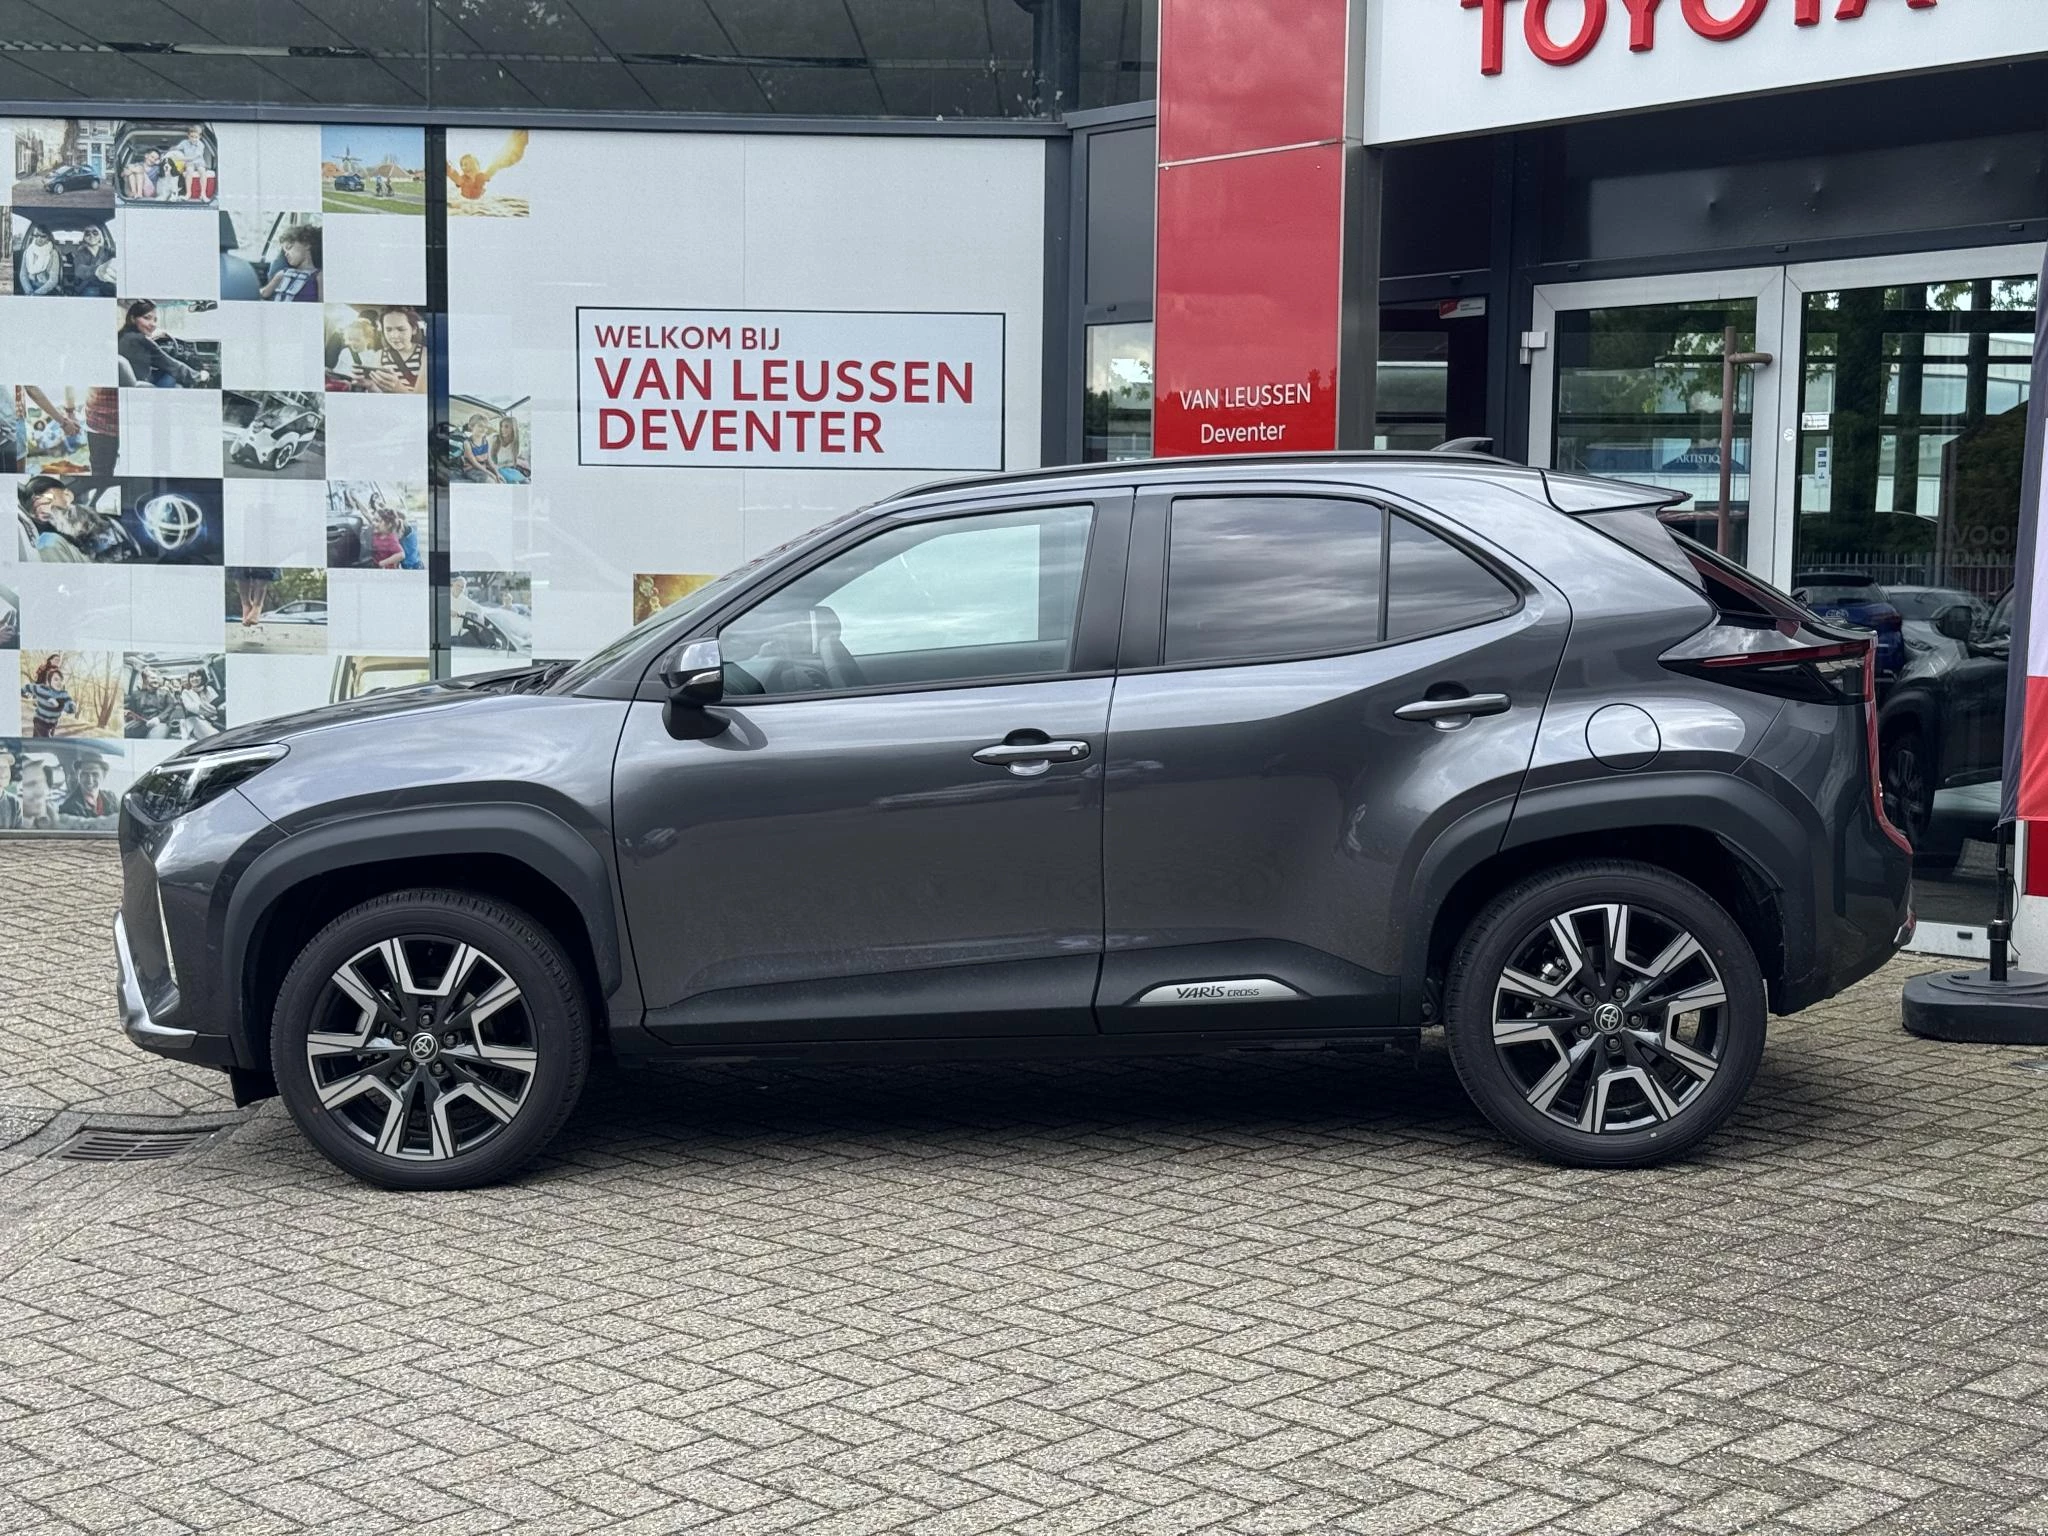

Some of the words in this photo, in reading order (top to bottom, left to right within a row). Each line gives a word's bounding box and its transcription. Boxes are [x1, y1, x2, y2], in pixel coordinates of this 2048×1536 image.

[1461, 0, 1938, 76] TOY
[595, 325, 731, 350] WELKOM
[742, 327, 780, 351] BIJ
[595, 358, 712, 401] VAN
[733, 360, 974, 404] LEUSSEN
[1180, 388, 1219, 410] VAN
[1225, 382, 1311, 408] LEUSSEN
[599, 408, 885, 454] DEVENTER
[1201, 421, 1286, 444] Deventer
[1675, 454, 1721, 465] ARTISTIQ
[1227, 988, 1260, 997] CROSS
